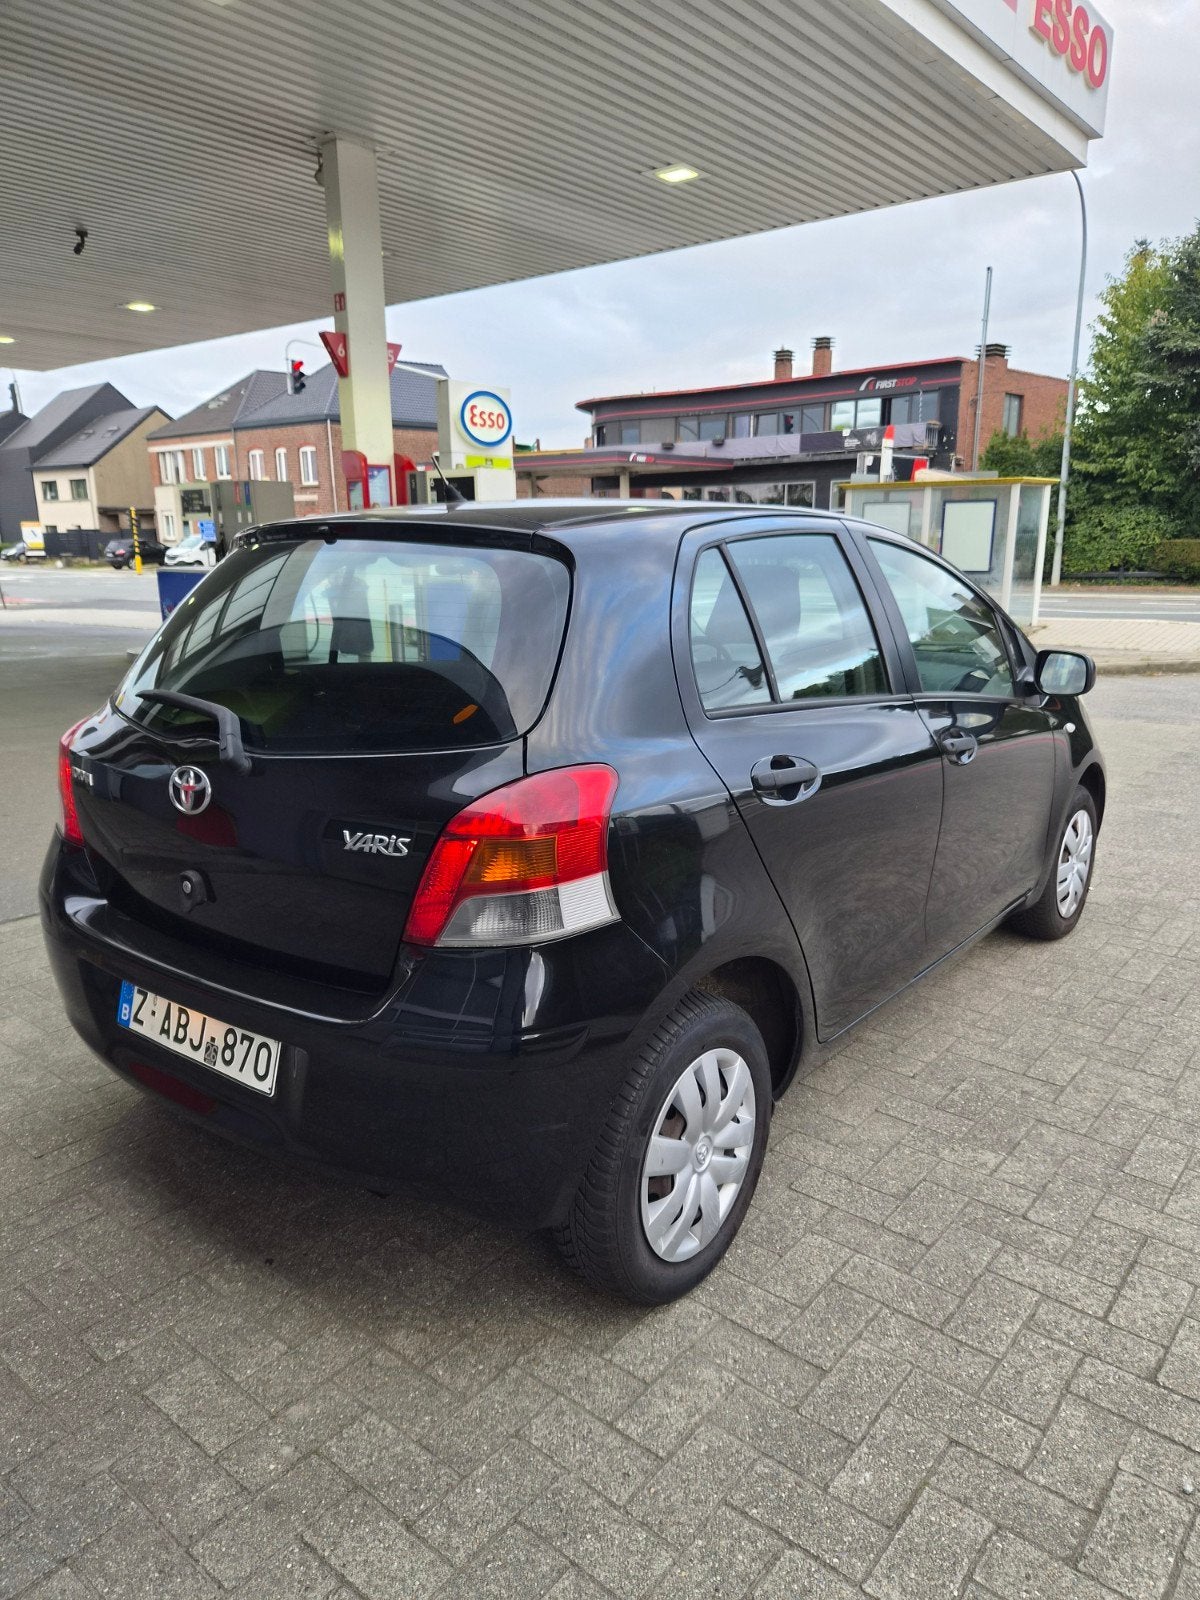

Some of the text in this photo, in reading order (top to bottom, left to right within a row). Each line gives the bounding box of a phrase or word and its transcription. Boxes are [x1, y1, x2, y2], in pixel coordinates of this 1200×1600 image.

[1029, 0, 1107, 88] ESSO
[337, 342, 346, 358] 6
[387, 349, 395, 363] 5
[121, 1003, 130, 1021] B
